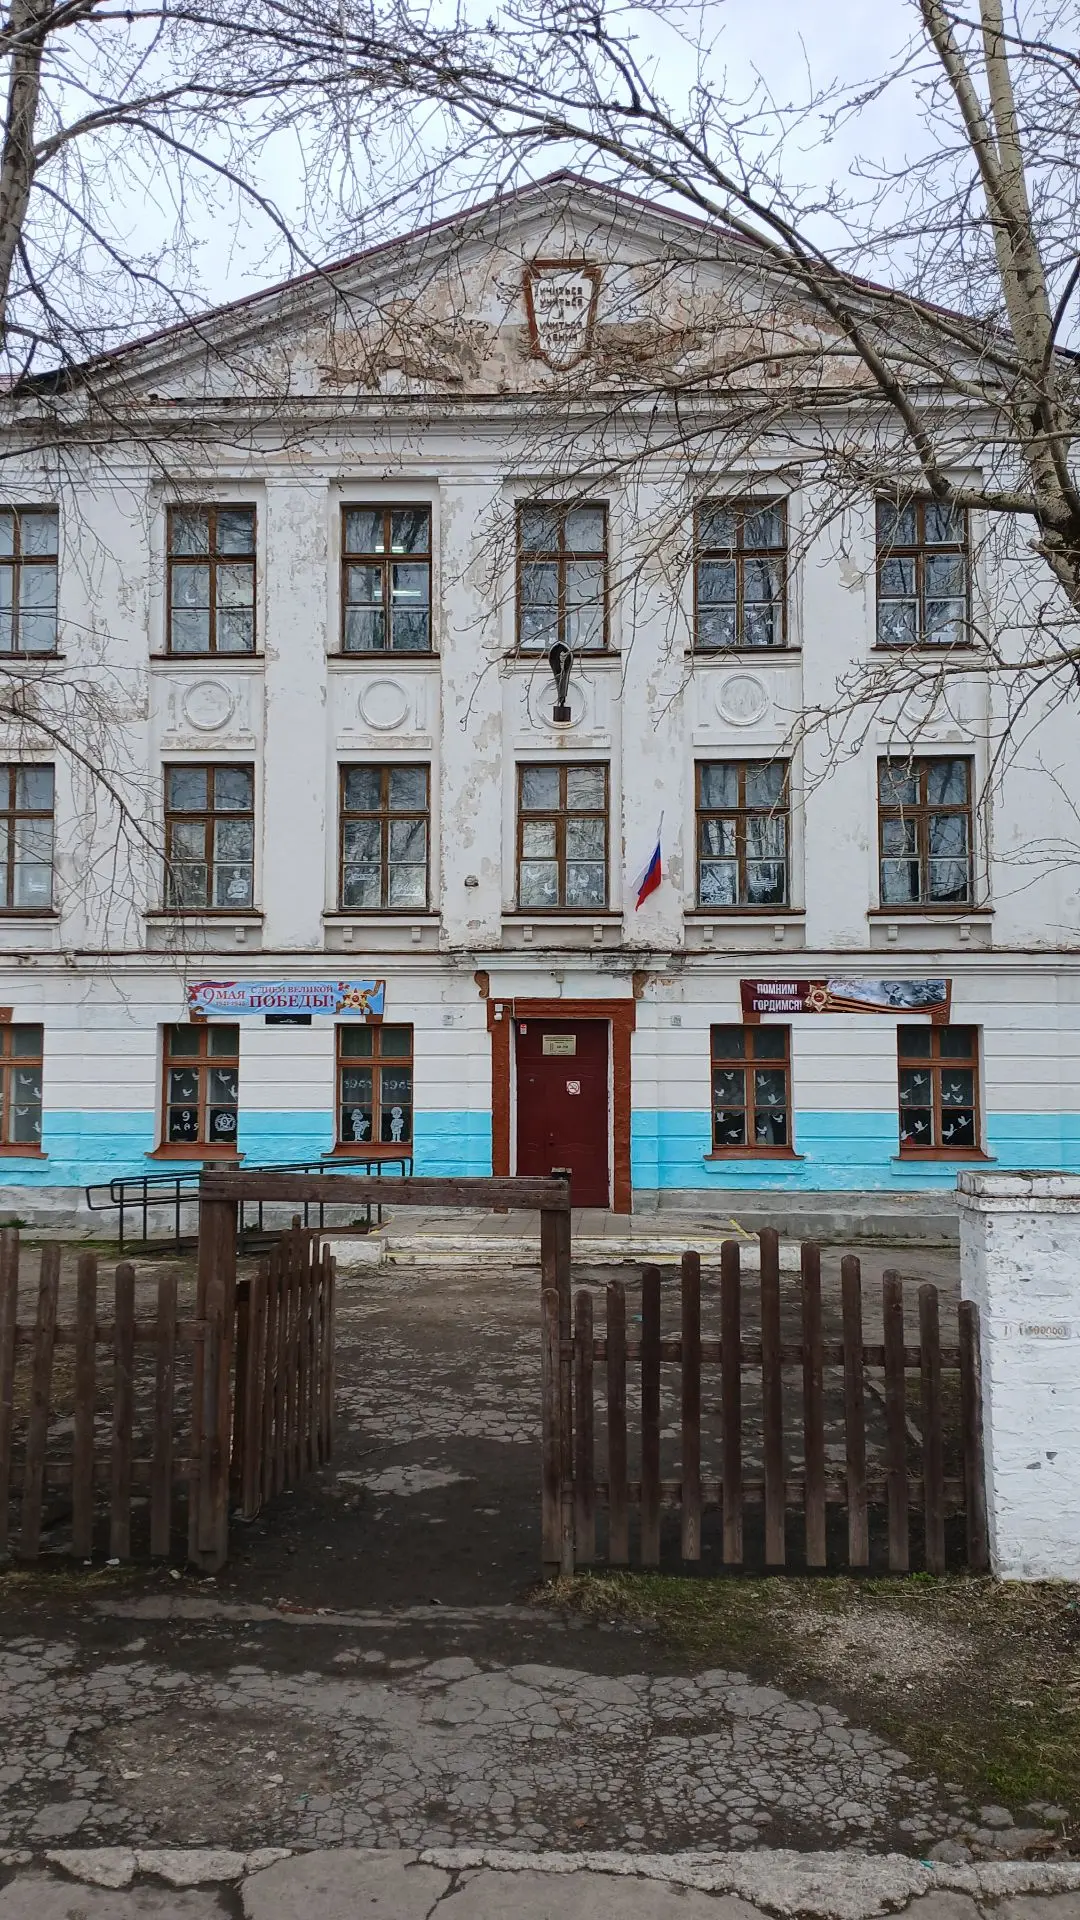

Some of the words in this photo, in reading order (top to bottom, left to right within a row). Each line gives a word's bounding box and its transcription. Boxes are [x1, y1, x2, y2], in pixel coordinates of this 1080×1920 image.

[288, 985, 333, 993] ВЕЛИКОЙ
[757, 984, 797, 995] ПОМНИМ!
[203, 988, 214, 1005] 9
[216, 991, 245, 999] МАЯ
[250, 995, 334, 1008] ПОБЕДЫ!
[753, 999, 802, 1011] ГОРДИМСЯ!
[182, 1111, 190, 1121] 9
